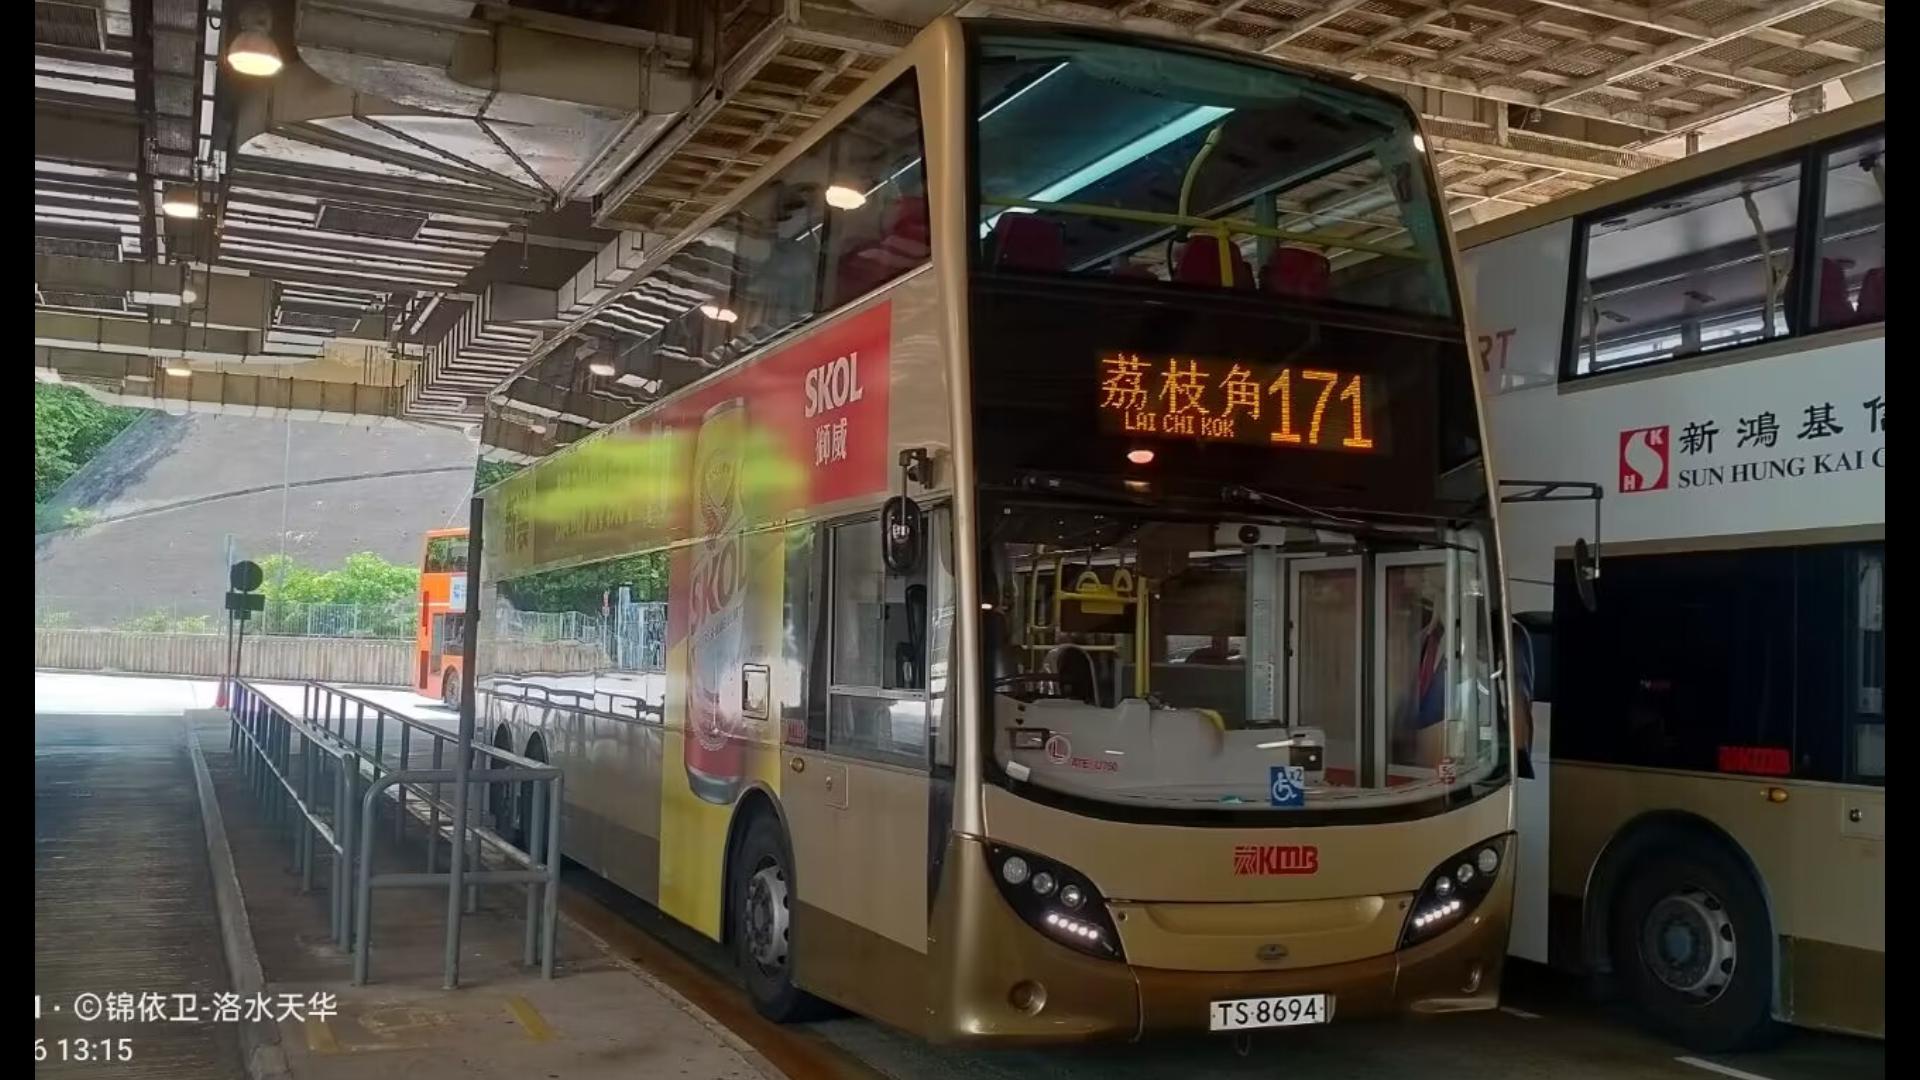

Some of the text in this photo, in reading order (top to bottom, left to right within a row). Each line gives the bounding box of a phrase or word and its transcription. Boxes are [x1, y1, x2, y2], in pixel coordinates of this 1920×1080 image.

[805, 352, 863, 418] SKOL
[1101, 353, 1260, 420] 荔枝角
[1125, 411, 1235, 438] LAI CHI KOK
[1268, 368, 1373, 448] 171
[815, 417, 848, 467] 獅威
[1678, 465, 1725, 489] SUN
[1731, 457, 1805, 483] HUNG
[1813, 450, 1865, 475] KAI
[1259, 845, 1319, 875] KMB
[1218, 998, 1318, 1026] TS 8694
